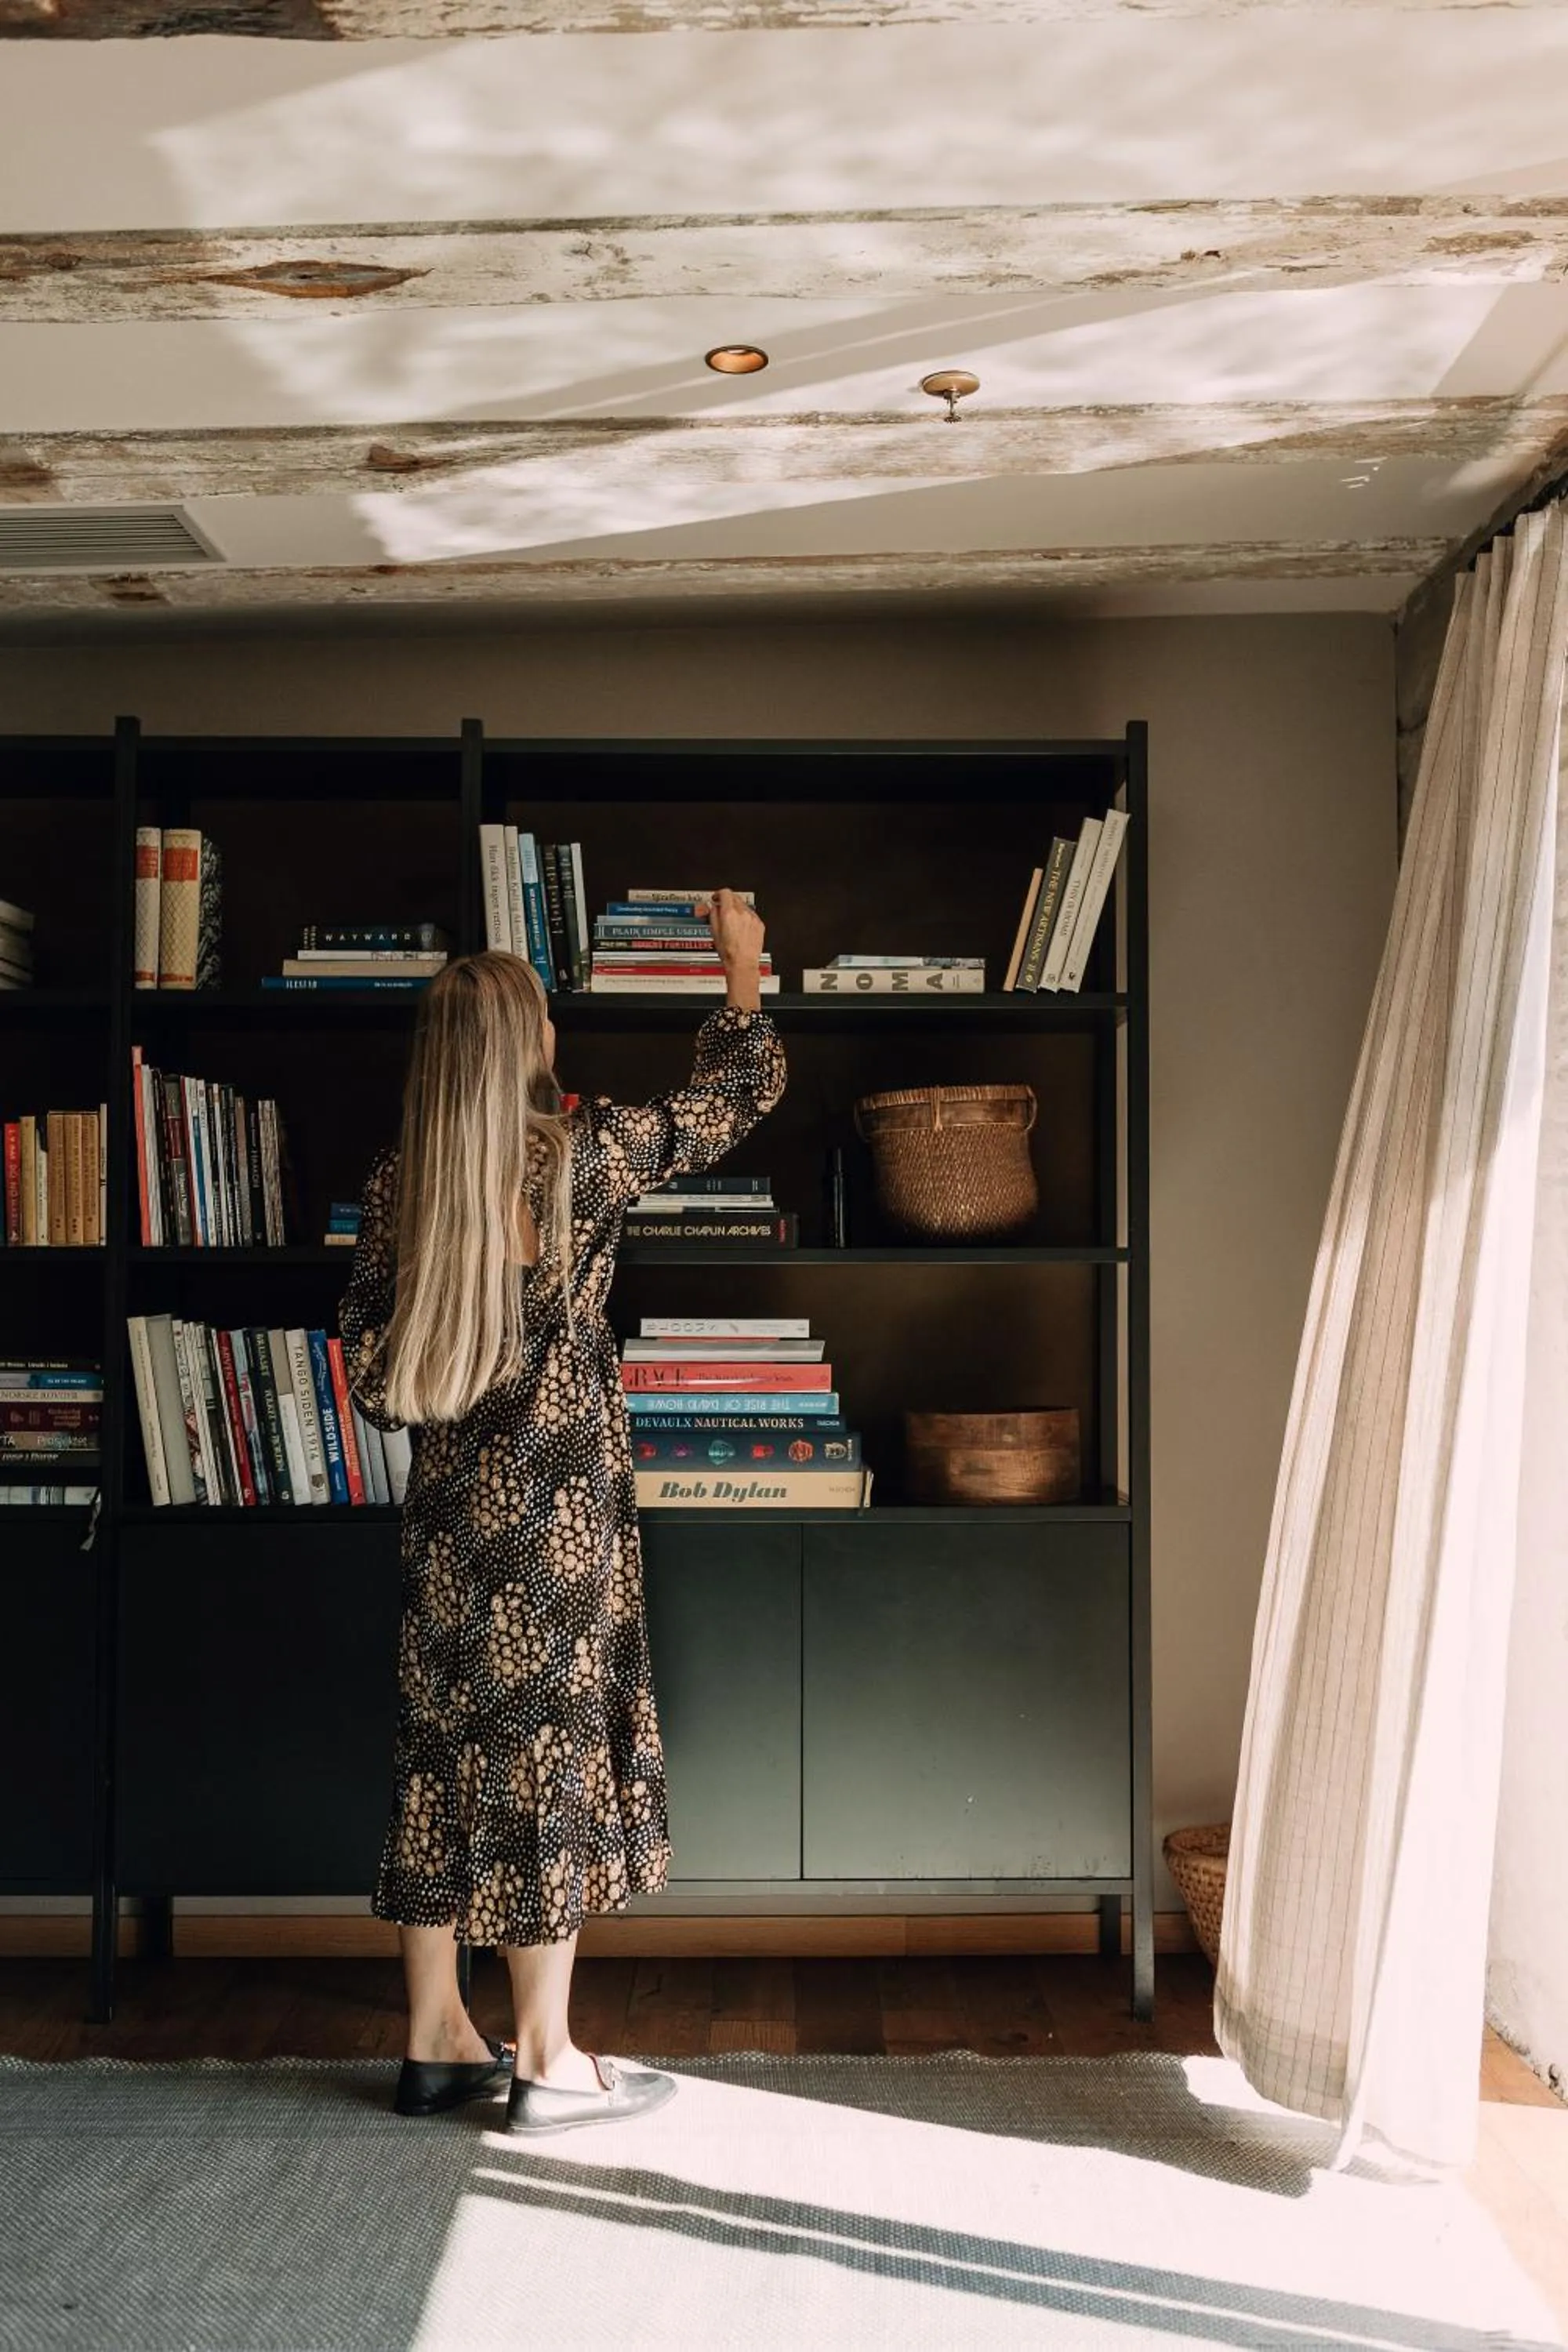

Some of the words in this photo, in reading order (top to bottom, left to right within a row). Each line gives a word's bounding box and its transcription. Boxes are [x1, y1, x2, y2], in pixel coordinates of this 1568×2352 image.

[325, 933, 411, 942] WAYWARD
[612, 927, 640, 936] PLAIN
[641, 927, 674, 936] SIMPLE
[820, 972, 943, 992] NOMA
[684, 1225, 725, 1236] CHAPLIN
[292, 1344, 308, 1385] TANGO
[299, 1389, 314, 1426] SIDEN
[635, 1417, 691, 1428] DEVAULX
[694, 1417, 757, 1428] NAUTICAL
[759, 1417, 804, 1428] WORKS
[322, 1407, 339, 1463] WILDSIDE
[659, 1481, 706, 1498] Bob
[712, 1481, 787, 1502] Dylan
